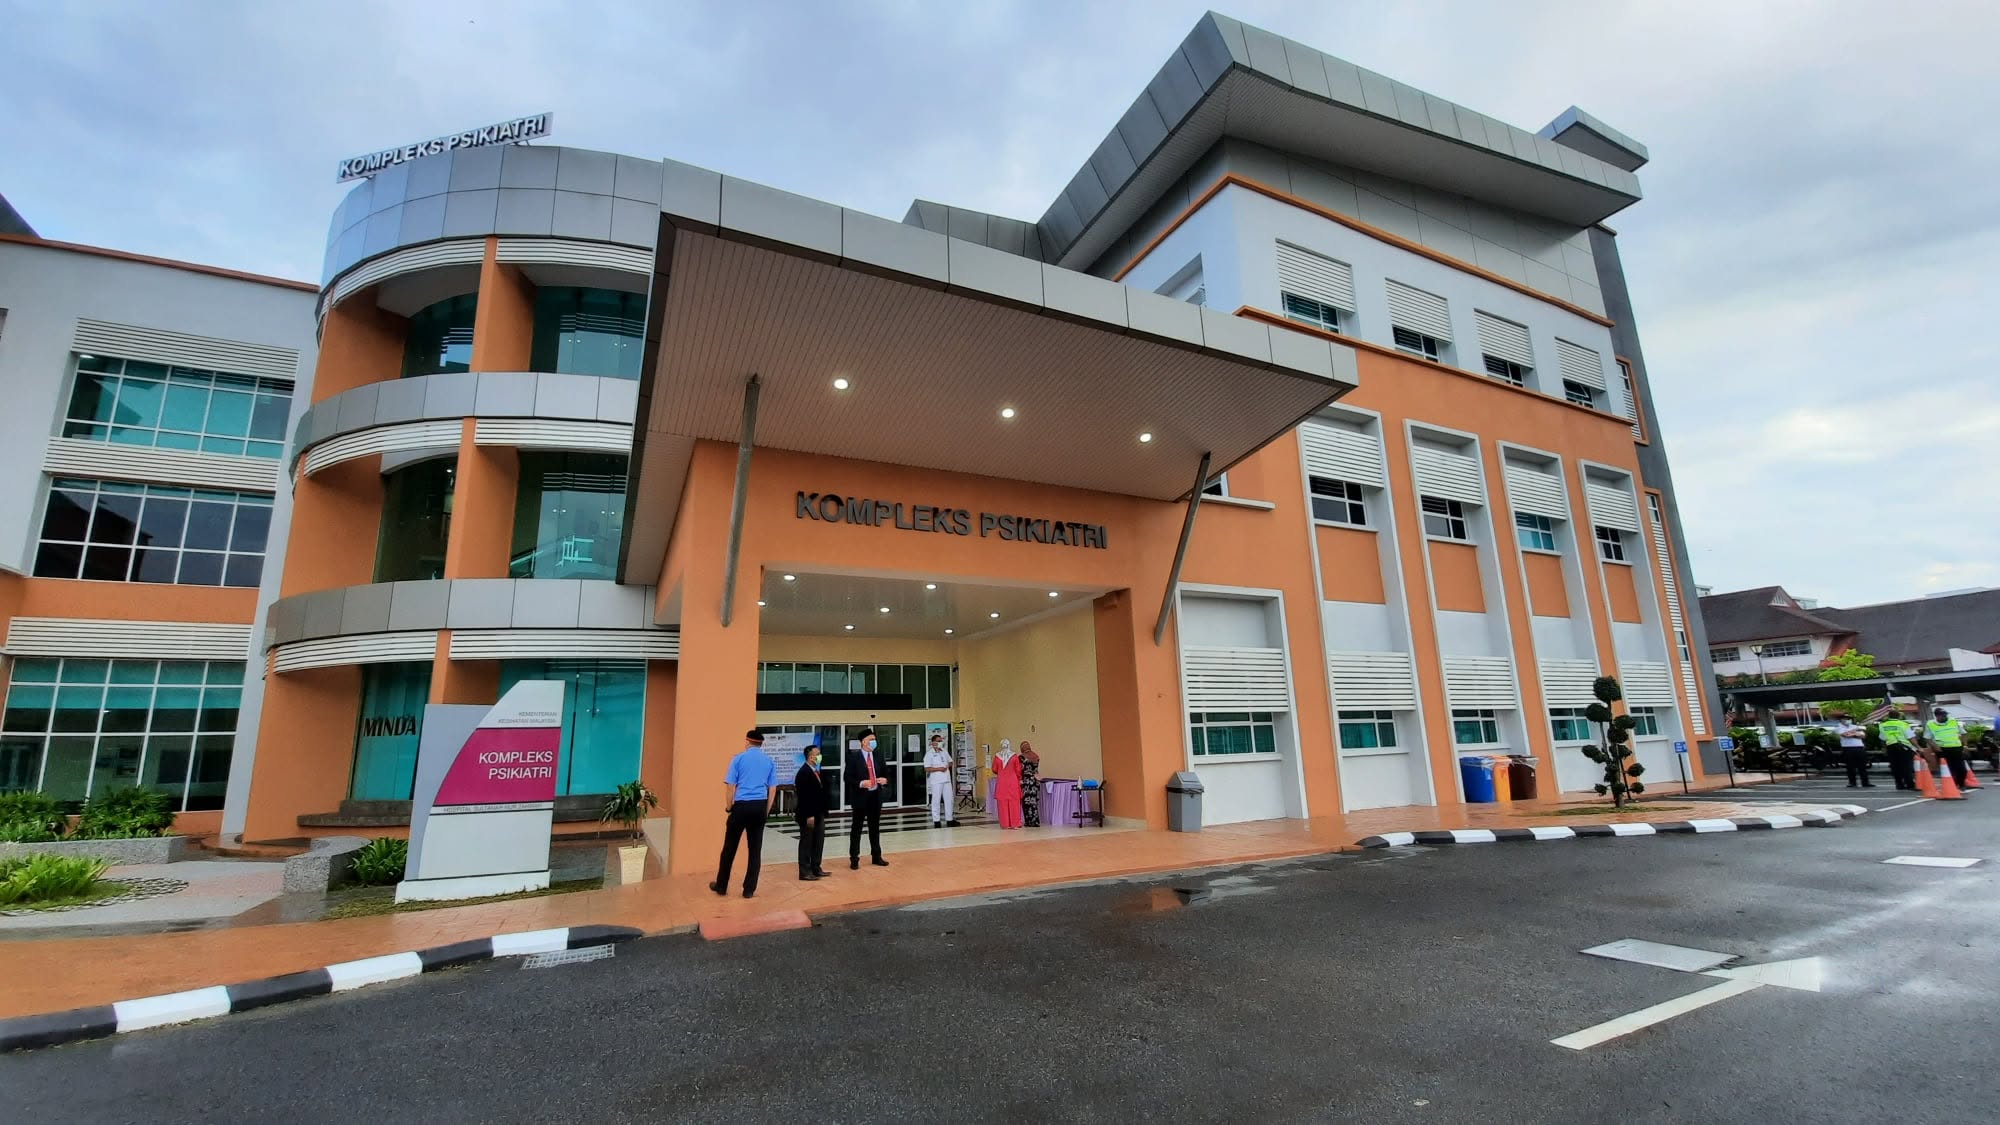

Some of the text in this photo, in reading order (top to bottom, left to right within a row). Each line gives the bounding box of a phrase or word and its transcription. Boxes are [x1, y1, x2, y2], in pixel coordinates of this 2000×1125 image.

[339, 115, 546, 178] KOMPLEKS PSIKIATRI
[795, 491, 1108, 549] KOMPLEKS PSIKIATRI
[362, 716, 416, 737] MINDA
[479, 751, 553, 764] KOMPLEKS
[488, 766, 552, 780] PSIKIATRI
